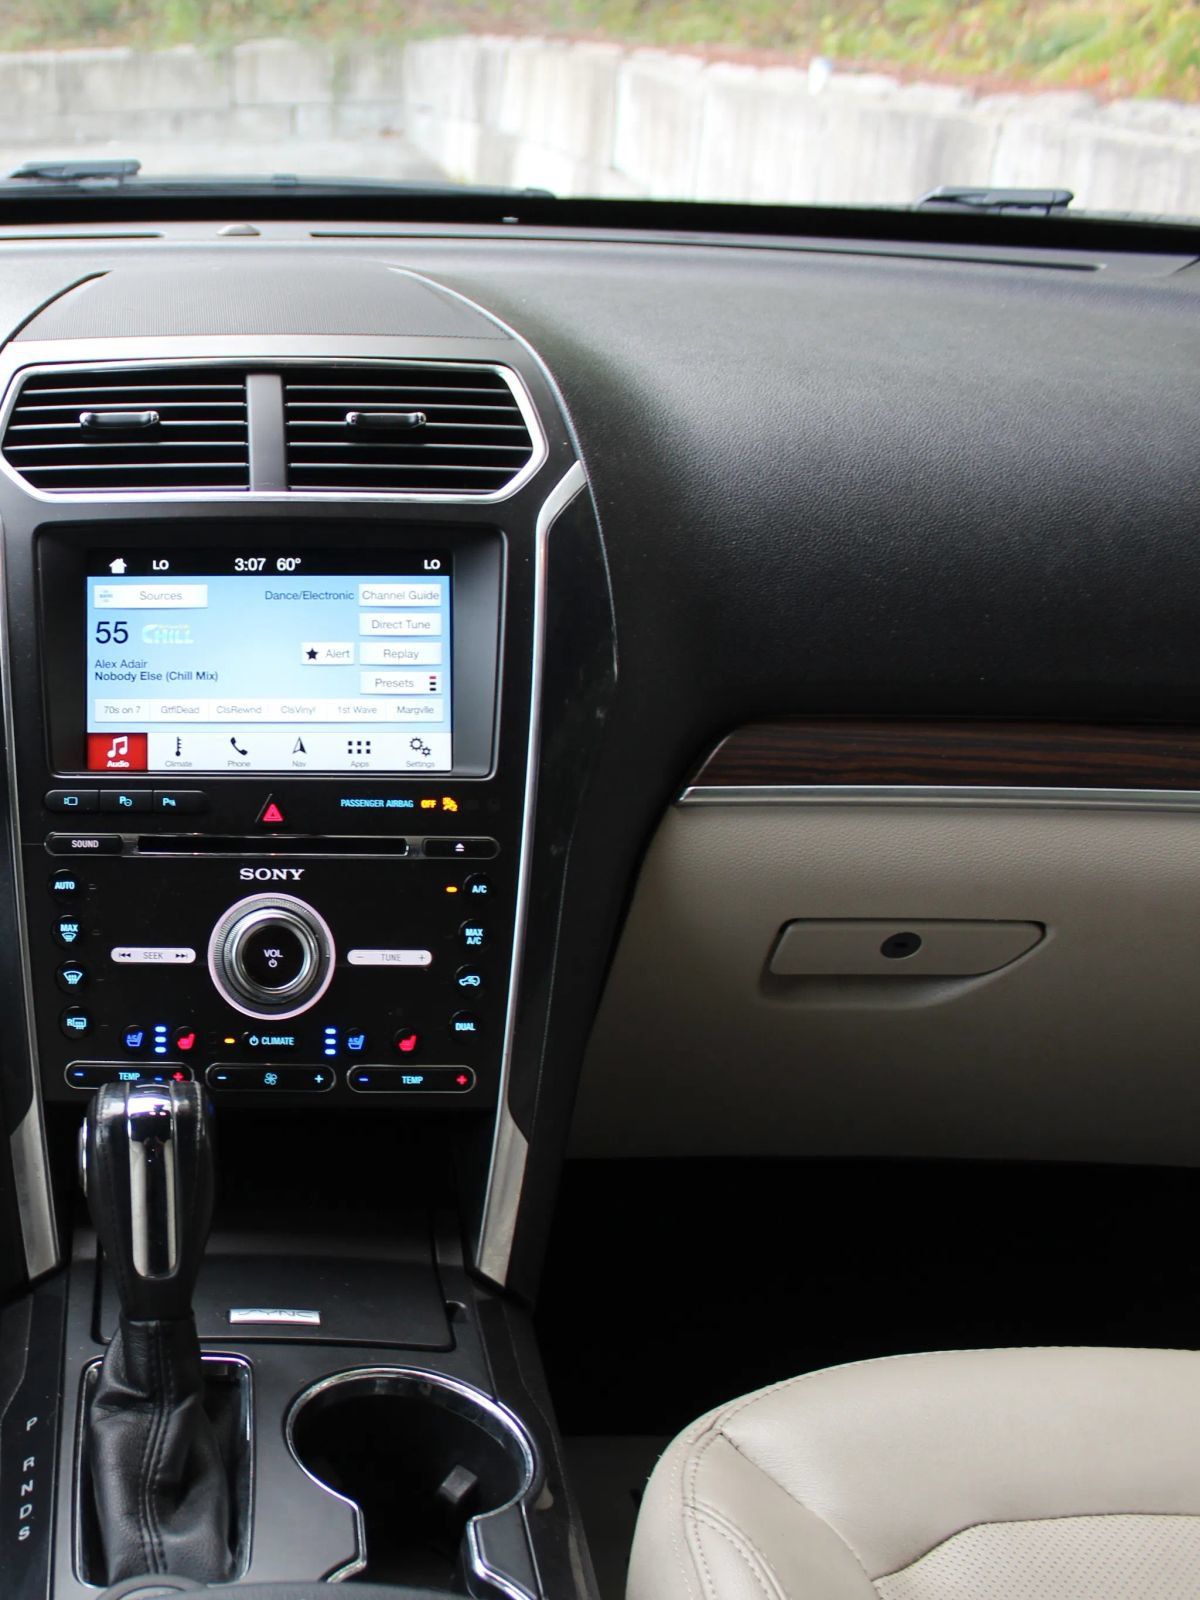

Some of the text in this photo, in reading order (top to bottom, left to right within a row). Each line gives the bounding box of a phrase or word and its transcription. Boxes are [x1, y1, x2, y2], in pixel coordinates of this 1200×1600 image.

[152, 559, 170, 570] LO
[234, 557, 266, 571] 3:07
[276, 557, 302, 571] 60°
[423, 559, 441, 570] LO
[139, 590, 183, 601] Sources
[264, 590, 355, 601] Dance/Electronic
[361, 590, 440, 600] Channel Guide
[371, 619, 431, 629] Direct Tune
[95, 621, 129, 644] 55
[325, 649, 350, 659] Alert
[383, 649, 419, 660] Replay
[94, 659, 149, 669] Alex Adair
[94, 672, 219, 683] Nobody Else (Chill Mix)
[374, 678, 414, 688] Presets
[104, 705, 120, 714] 70s
[136, 705, 141, 714] 7
[337, 705, 378, 714] 1st Wave
[106, 760, 130, 768] Audio
[164, 760, 193, 768] Climate
[227, 760, 251, 768] Phone
[292, 760, 306, 768] Nav
[350, 760, 370, 769] Apps
[405, 760, 435, 769] Settings
[340, 799, 437, 809] PASSENGER AIRBAG OFF
[71, 839, 99, 848] SOUND
[239, 868, 305, 880] SONY
[54, 881, 75, 890] AUTO
[471, 884, 487, 894] A/C
[60, 924, 78, 932] MAX
[465, 928, 483, 937] MAX
[466, 936, 482, 945] A/C
[143, 951, 164, 960] SEEK
[263, 949, 284, 958] VOL
[381, 953, 401, 962] TUNE
[455, 1022, 477, 1031] DUAL
[261, 1037, 295, 1046] CLIMATE
[118, 1072, 141, 1081] TEMP
[401, 1075, 424, 1084] TEMP
[25, 1416, 38, 1431] P
[20, 1479, 34, 1496] N
[19, 1503, 33, 1519] D
[18, 1526, 30, 1541] S
